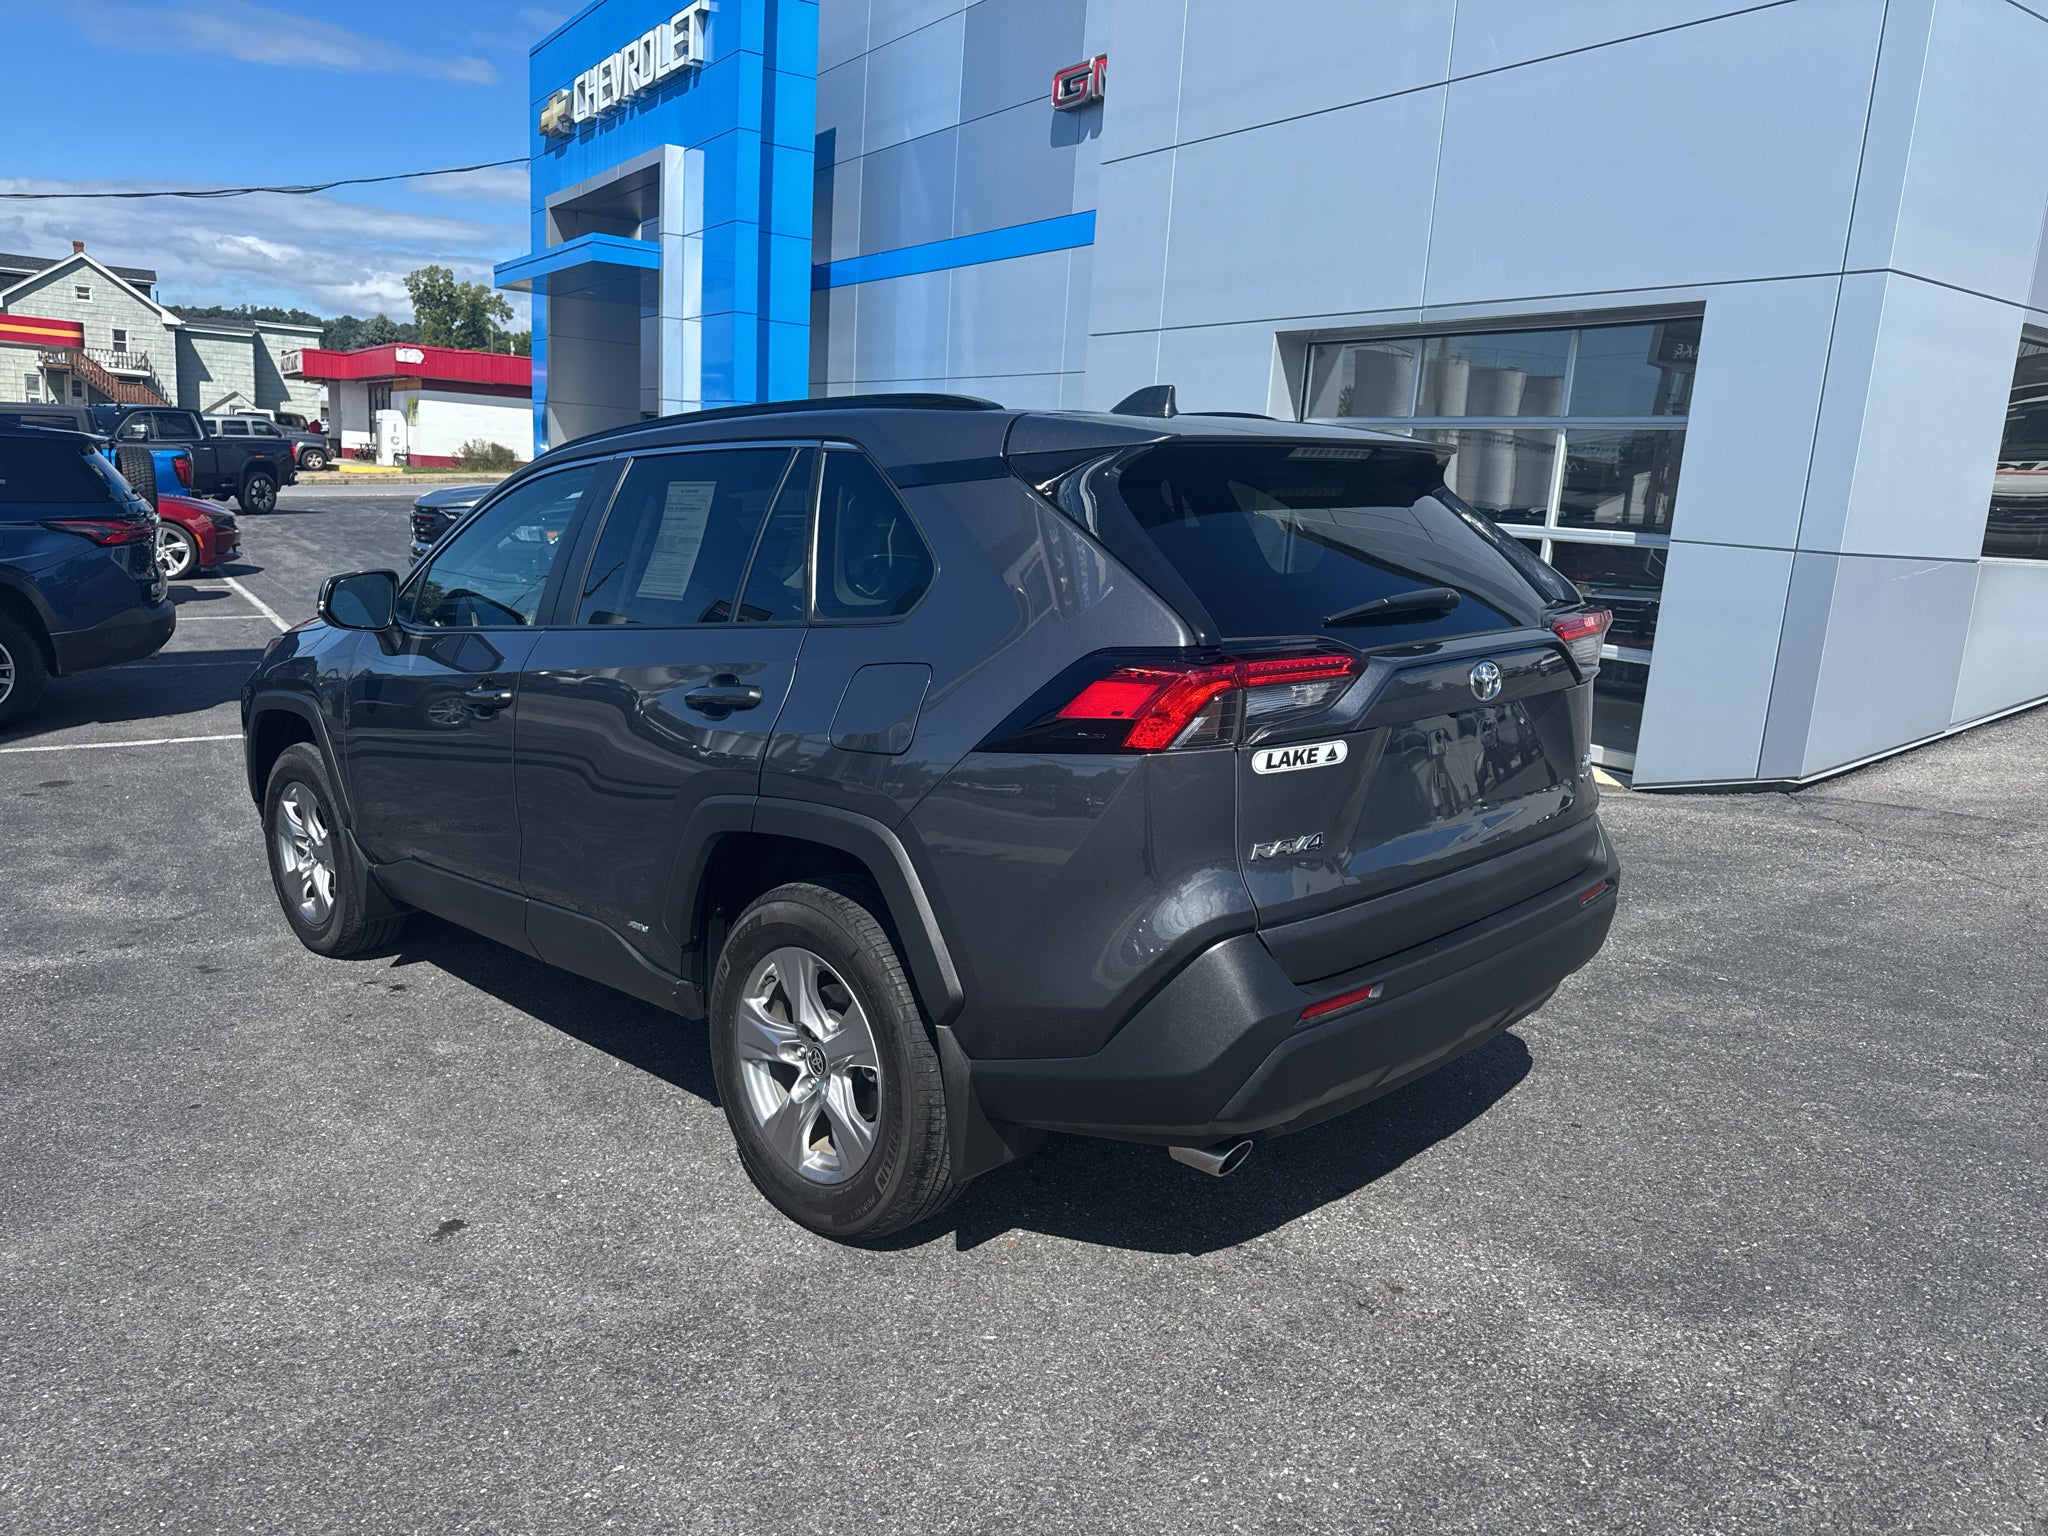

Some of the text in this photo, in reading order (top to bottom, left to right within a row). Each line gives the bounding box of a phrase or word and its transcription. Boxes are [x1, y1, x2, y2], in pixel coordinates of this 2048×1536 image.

[574, 0, 709, 124] CHEVROLET
[1265, 747, 1319, 770] LAKE
[1249, 832, 1324, 862] RAV4
